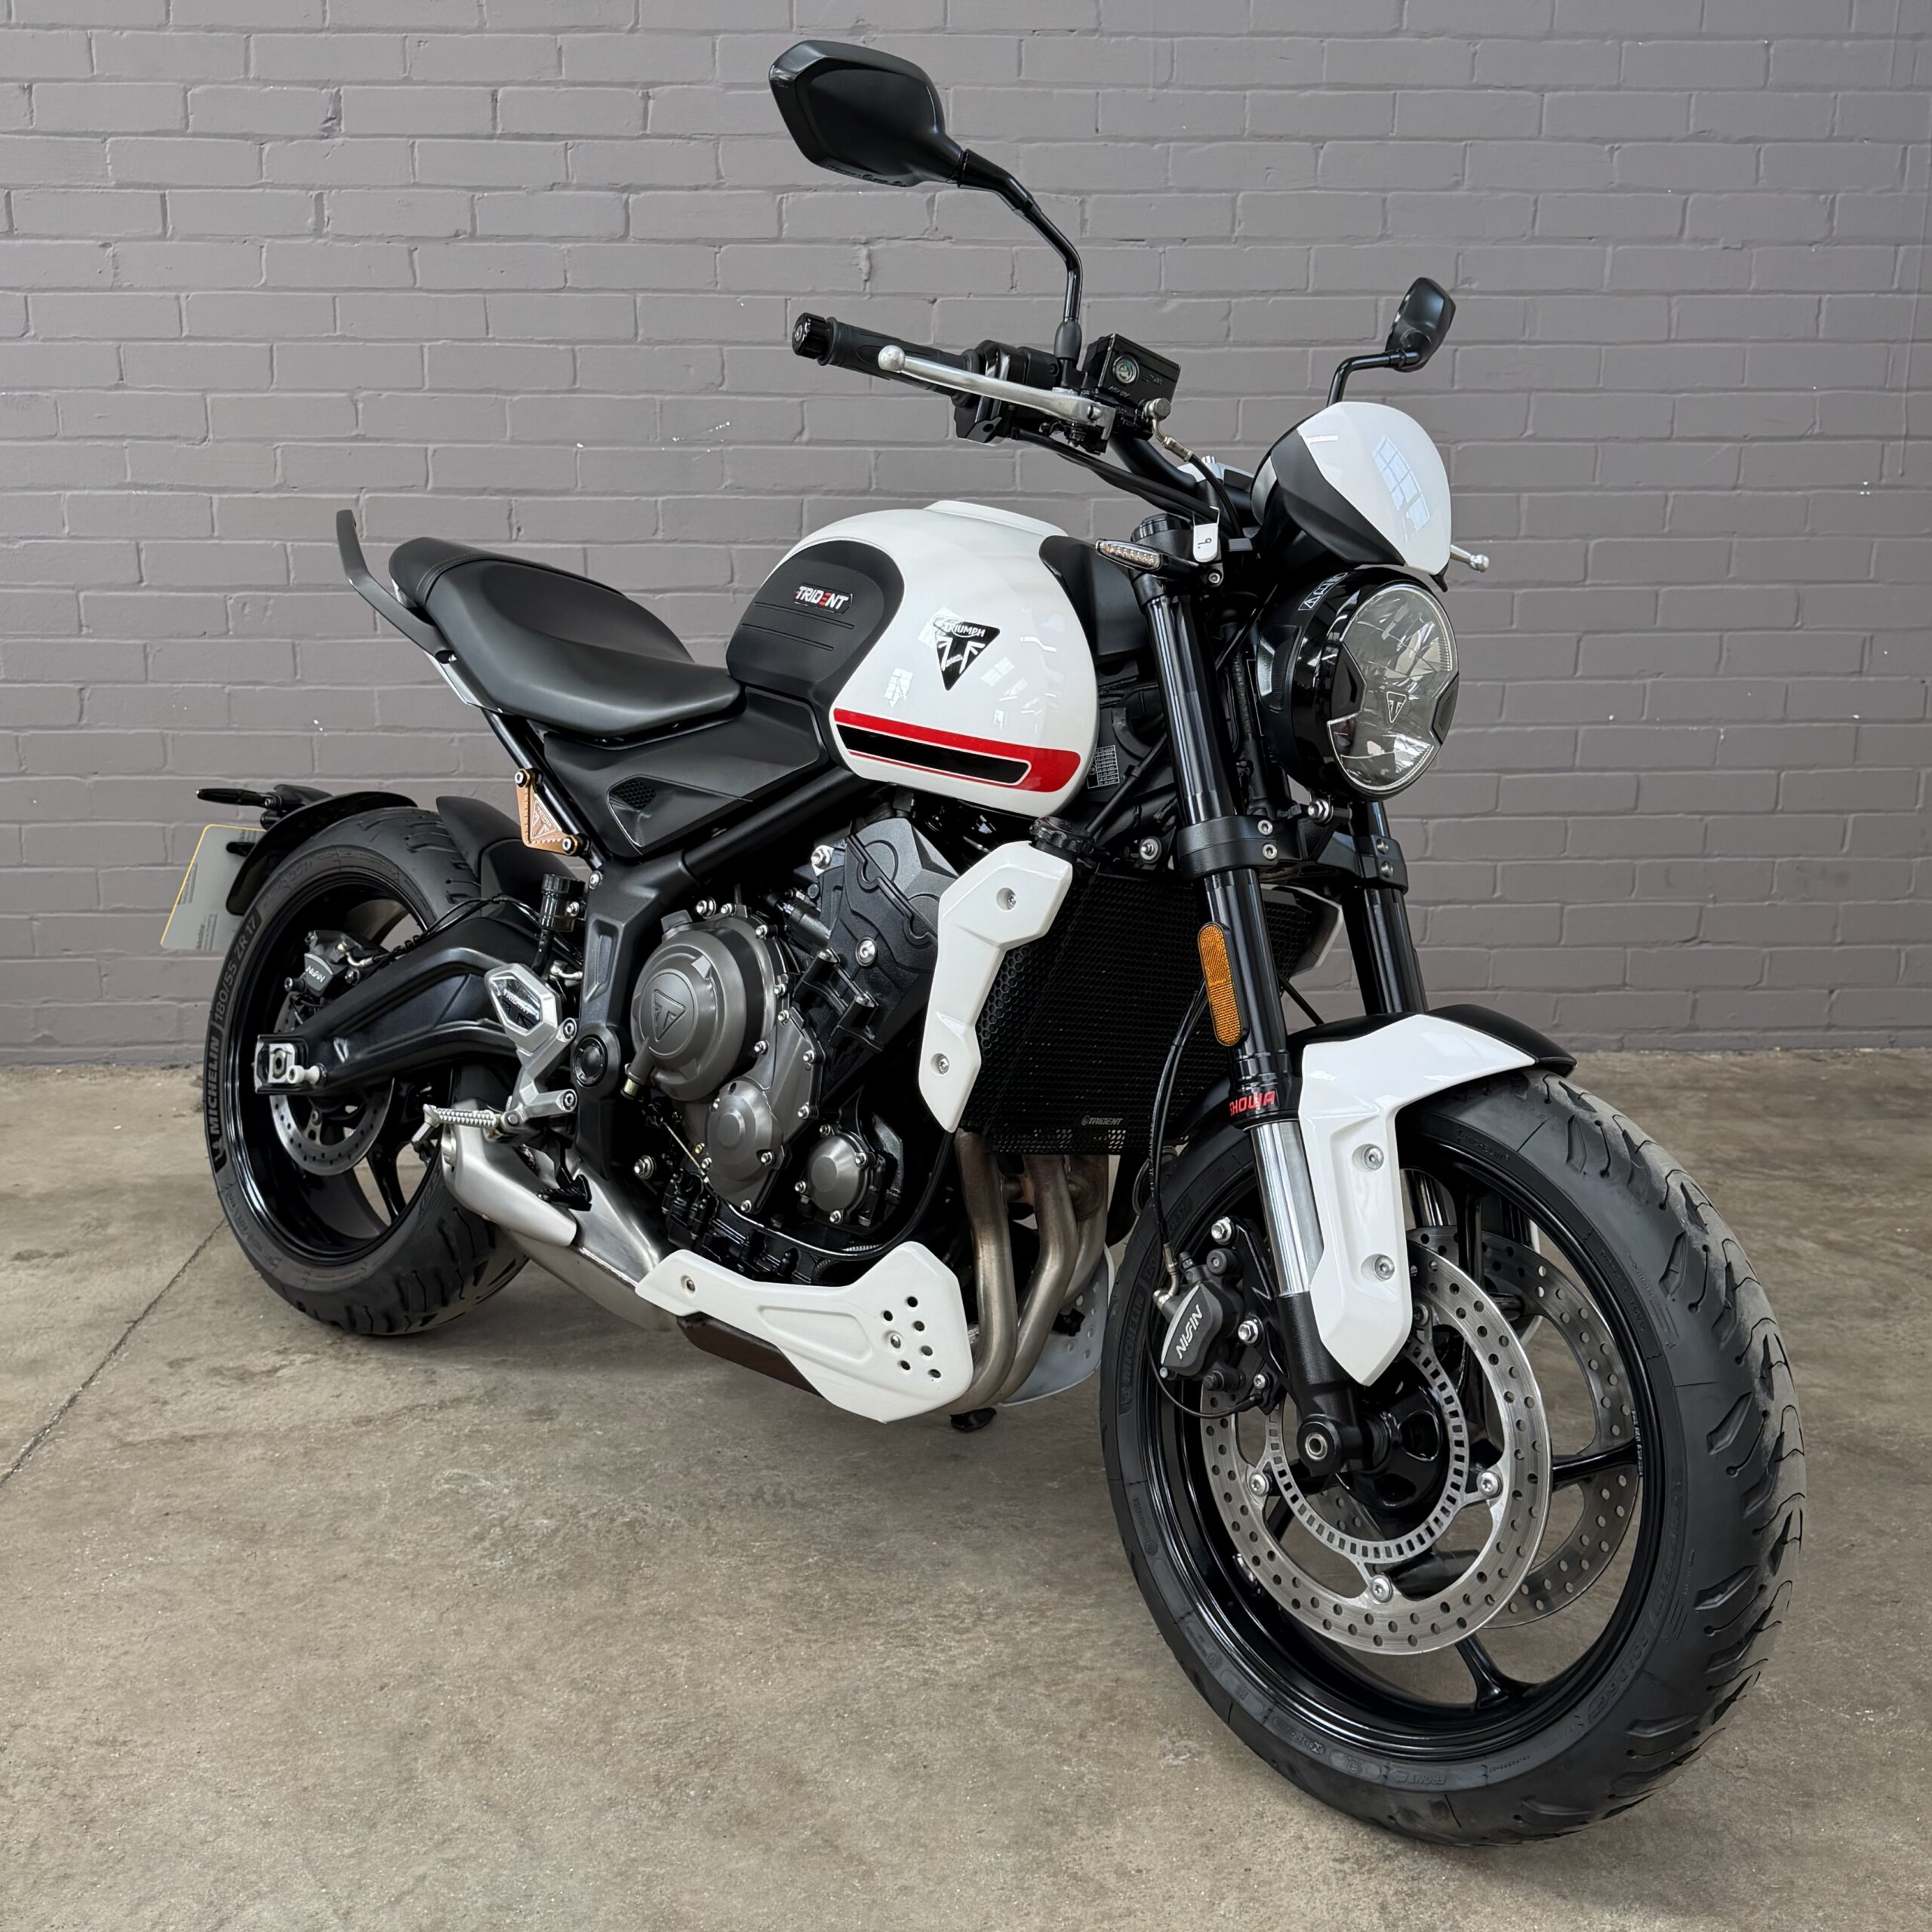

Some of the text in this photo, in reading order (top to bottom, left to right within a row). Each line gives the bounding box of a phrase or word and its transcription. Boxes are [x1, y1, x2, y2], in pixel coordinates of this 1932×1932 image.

[795, 586, 850, 610] TRIDENT
[208, 915, 257, 1135] MICHELIN 180/55 ZR 17
[1088, 1117, 1124, 1125] TRIDENT
[1176, 1304, 1203, 1359] NISSIN
